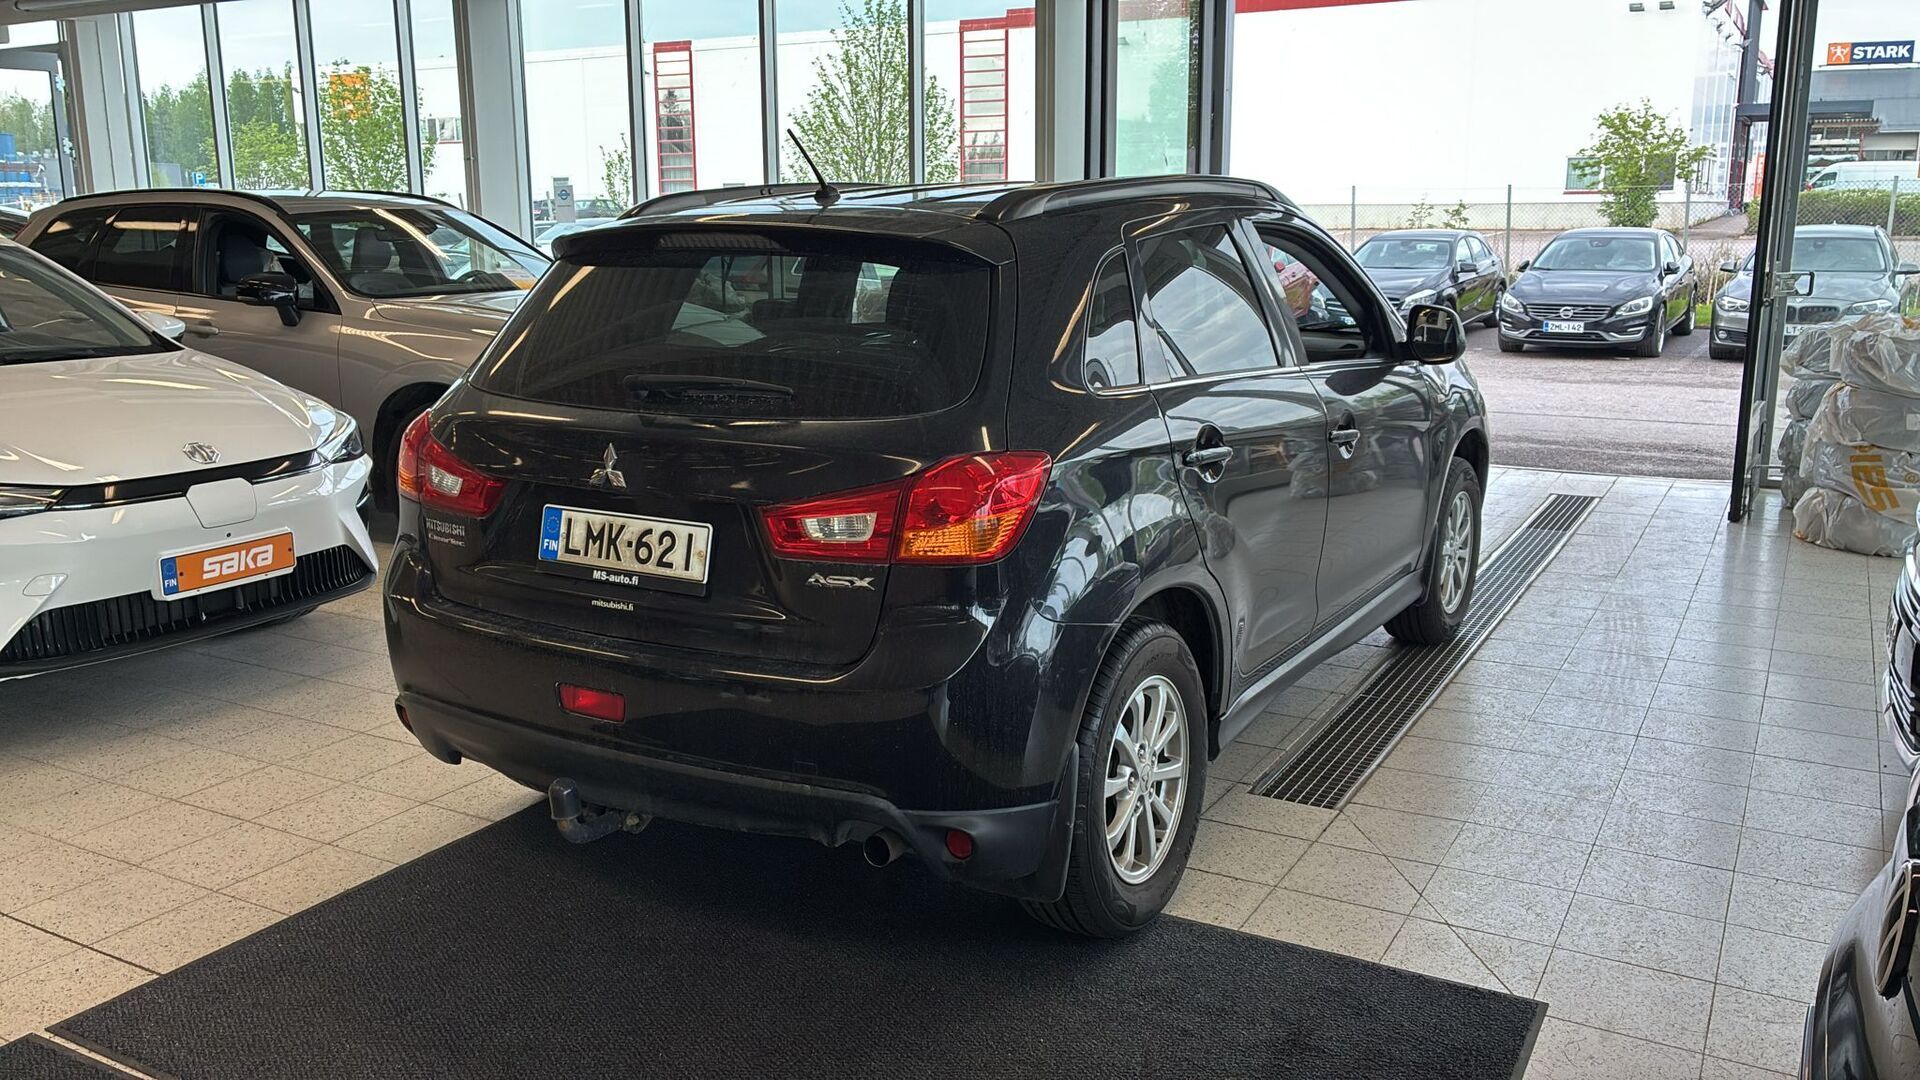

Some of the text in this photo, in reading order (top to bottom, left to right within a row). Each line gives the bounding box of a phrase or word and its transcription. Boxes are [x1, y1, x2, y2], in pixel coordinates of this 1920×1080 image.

[1852, 44, 1912, 60] STARK
[195, 172, 204, 185] P
[1549, 323, 1583, 332] ZML-142
[426, 517, 465, 537] MITSUBISHI
[544, 538, 559, 552] FIN
[564, 517, 694, 572] LMK-621
[202, 543, 274, 580] saka
[164, 577, 178, 588] FIN
[592, 569, 639, 586] MS-auto.fi
[805, 572, 876, 591] ASX
[591, 599, 634, 612] mitsubishi.fi
